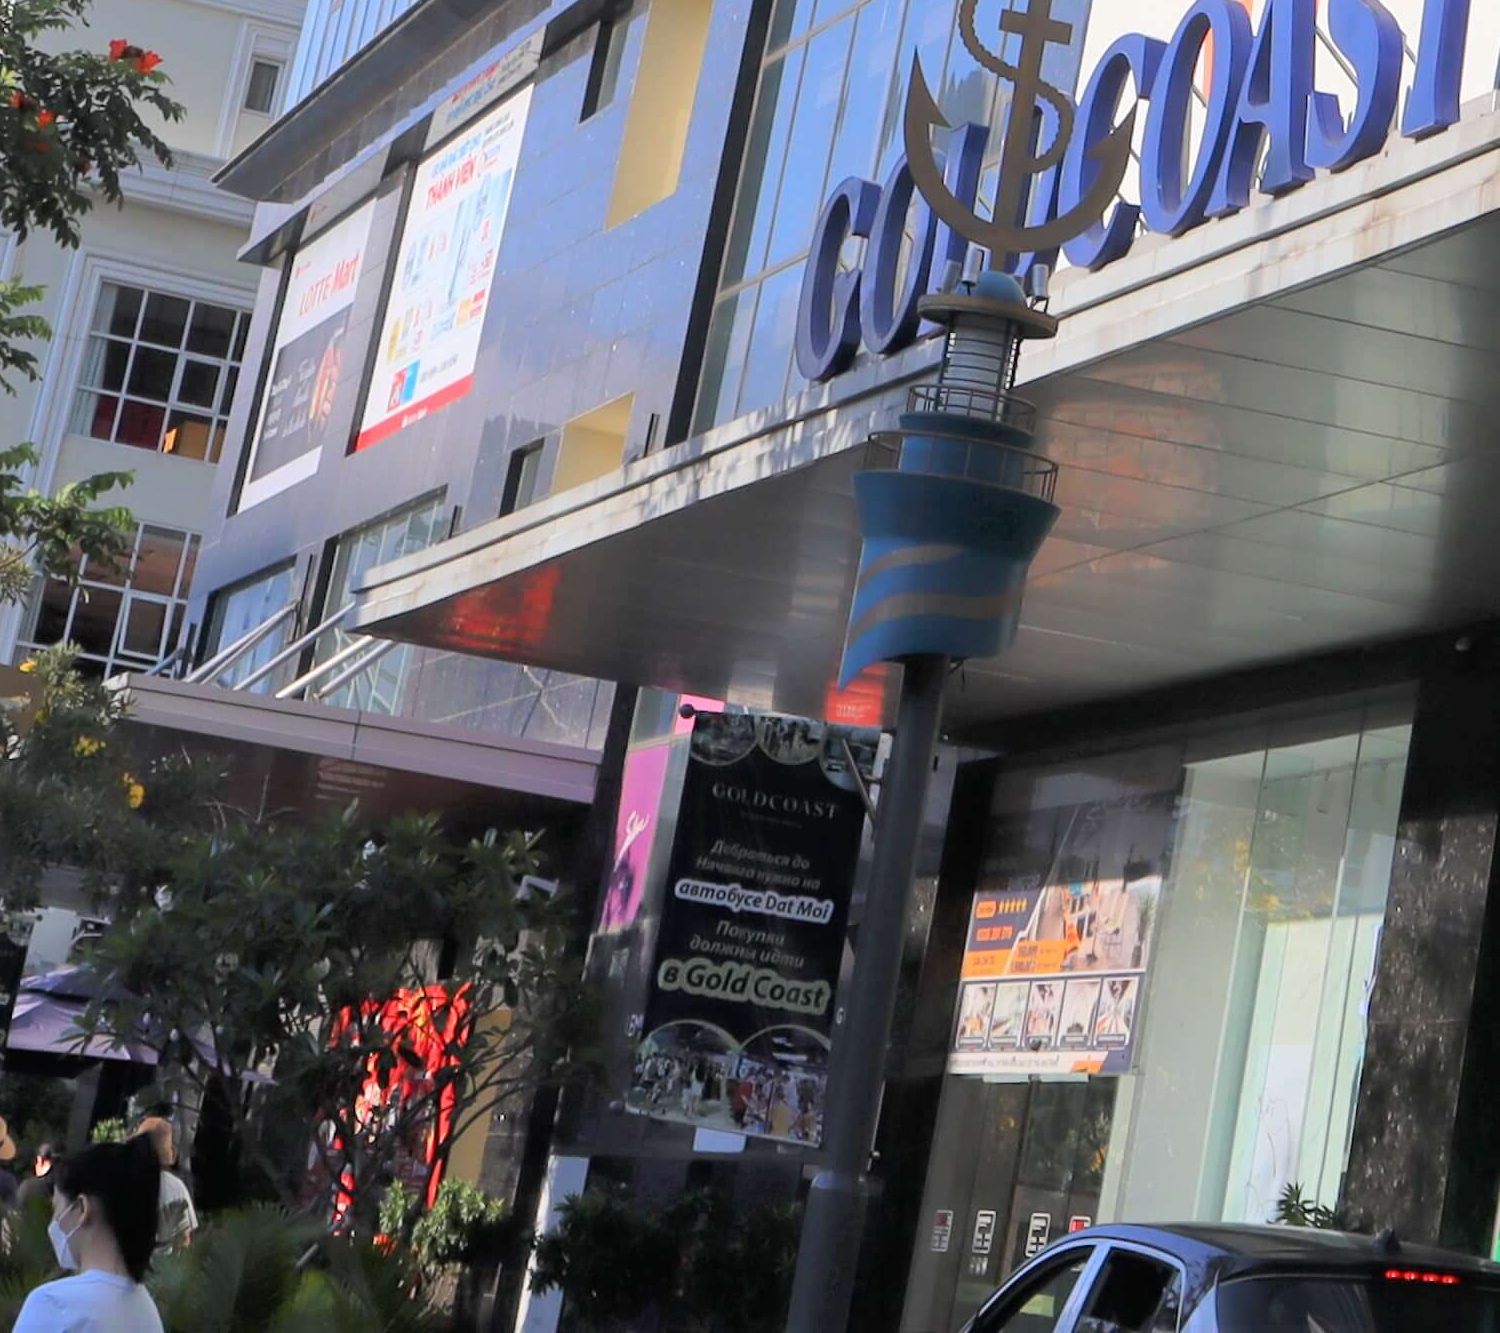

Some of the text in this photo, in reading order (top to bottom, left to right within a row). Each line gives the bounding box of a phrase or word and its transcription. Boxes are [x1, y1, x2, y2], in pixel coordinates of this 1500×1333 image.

[300, 274, 331, 316] LOTTE
[712, 783, 839, 820] GOLDCOAST
[679, 882, 763, 910] автобусе
[765, 893, 794, 913] Dat
[686, 964, 750, 995] Gold
[753, 975, 825, 1009] Coast
